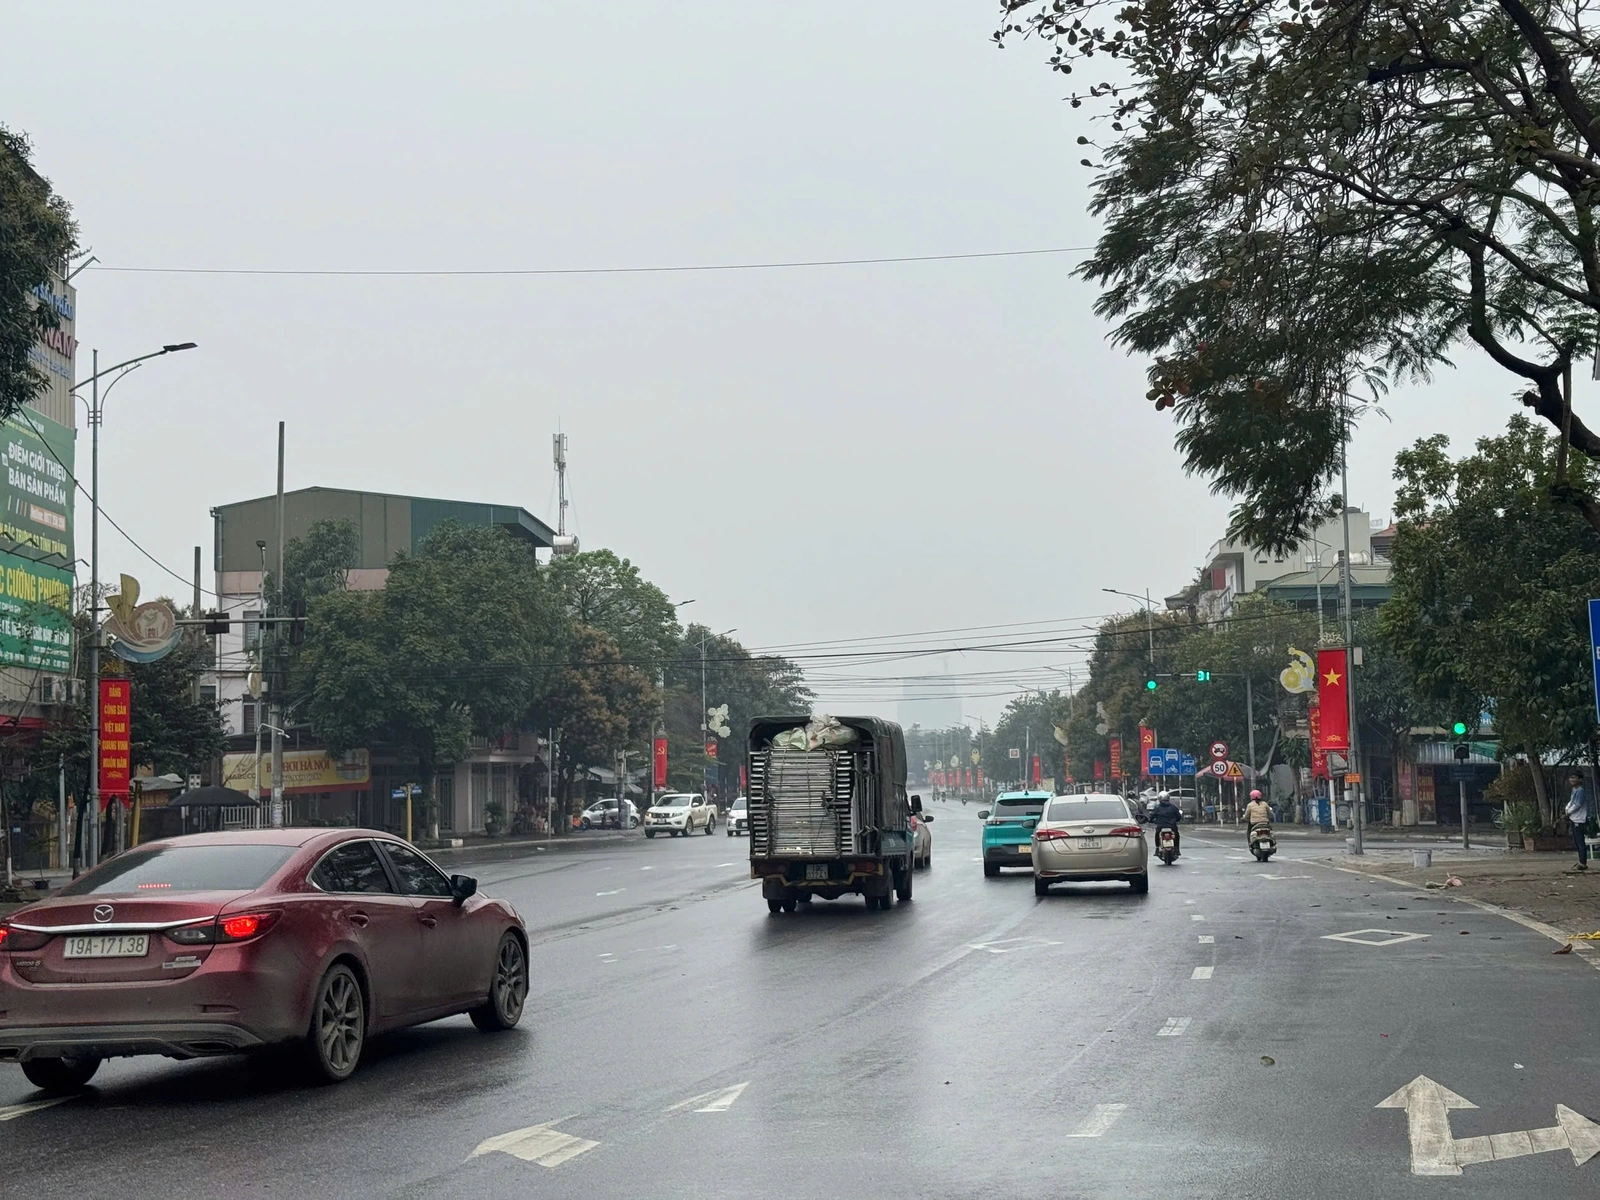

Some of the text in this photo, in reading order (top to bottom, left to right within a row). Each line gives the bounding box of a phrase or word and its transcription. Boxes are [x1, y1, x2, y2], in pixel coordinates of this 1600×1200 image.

[8, 439, 28, 466] ĐIỂM
[29, 450, 45, 474] GIỚI
[8, 466, 27, 491] BÁN
[27, 471, 43, 498] SẢN
[6, 564, 37, 602] CƯỜNG
[104, 720, 114, 734] VIỆT
[1214, 764, 1225, 772] 50
[70, 937, 145, 955] 19A-171.38
